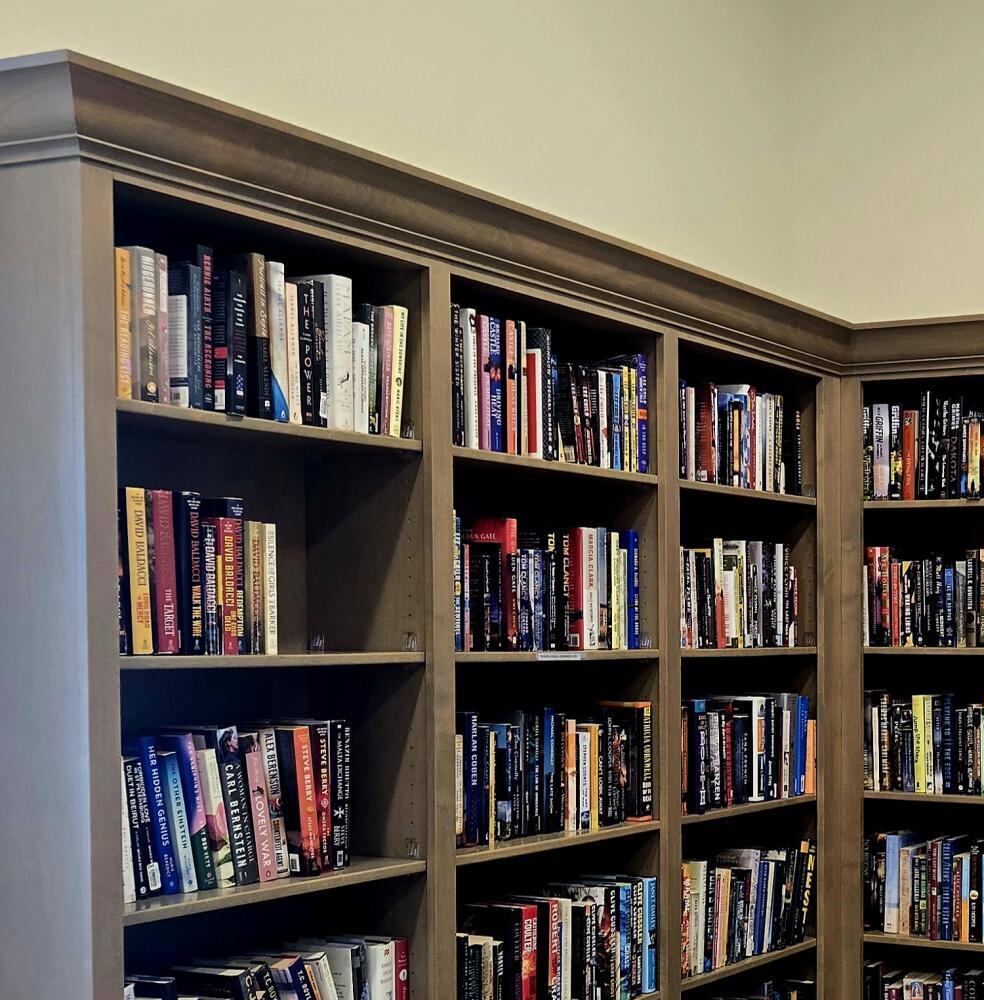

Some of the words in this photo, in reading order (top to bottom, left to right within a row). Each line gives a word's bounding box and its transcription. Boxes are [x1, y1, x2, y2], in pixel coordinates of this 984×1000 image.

[119, 310, 129, 325] THE
[120, 329, 130, 363] READING
[204, 325, 212, 340] THE
[121, 366, 131, 383] LIST
[204, 343, 212, 388] RECKONING
[304, 345, 312, 406] POWER
[134, 509, 144, 538] DAVID
[190, 512, 199, 538] DAVID
[235, 520, 243, 544] DAVID
[136, 541, 146, 586] BALDACCI
[191, 540, 200, 582] BALDACCI
[205, 546, 215, 571] DAVID
[224, 536, 233, 562] DAVID
[252, 539, 260, 568] DAVID
[192, 585, 201, 605] WALK
[206, 573, 216, 614] BALDACCI
[225, 565, 234, 606] BALDACCI
[164, 603, 174, 636] TARGET
[193, 606, 201, 618] THE
[193, 621, 202, 637] WIRE
[147, 746, 158, 766] HER
[264, 733, 275, 753] ALEX
[301, 744, 310, 773] STEVE
[125, 765, 136, 787] DUET
[151, 768, 163, 806] HIDDEN
[224, 764, 236, 795] CARL
[267, 754, 279, 795] BERENSON
[303, 775, 312, 802] BERRY
[172, 778, 182, 807] OTHER
[129, 798, 139, 829] BEIRUT
[157, 809, 169, 846] GENIUS
[176, 809, 187, 849] EINSTEIN
[229, 801, 247, 868] BERNSTEIN
[254, 795, 268, 836] LOVELY
[261, 840, 271, 867] WAR
[524, 919, 532, 953] COULTER
